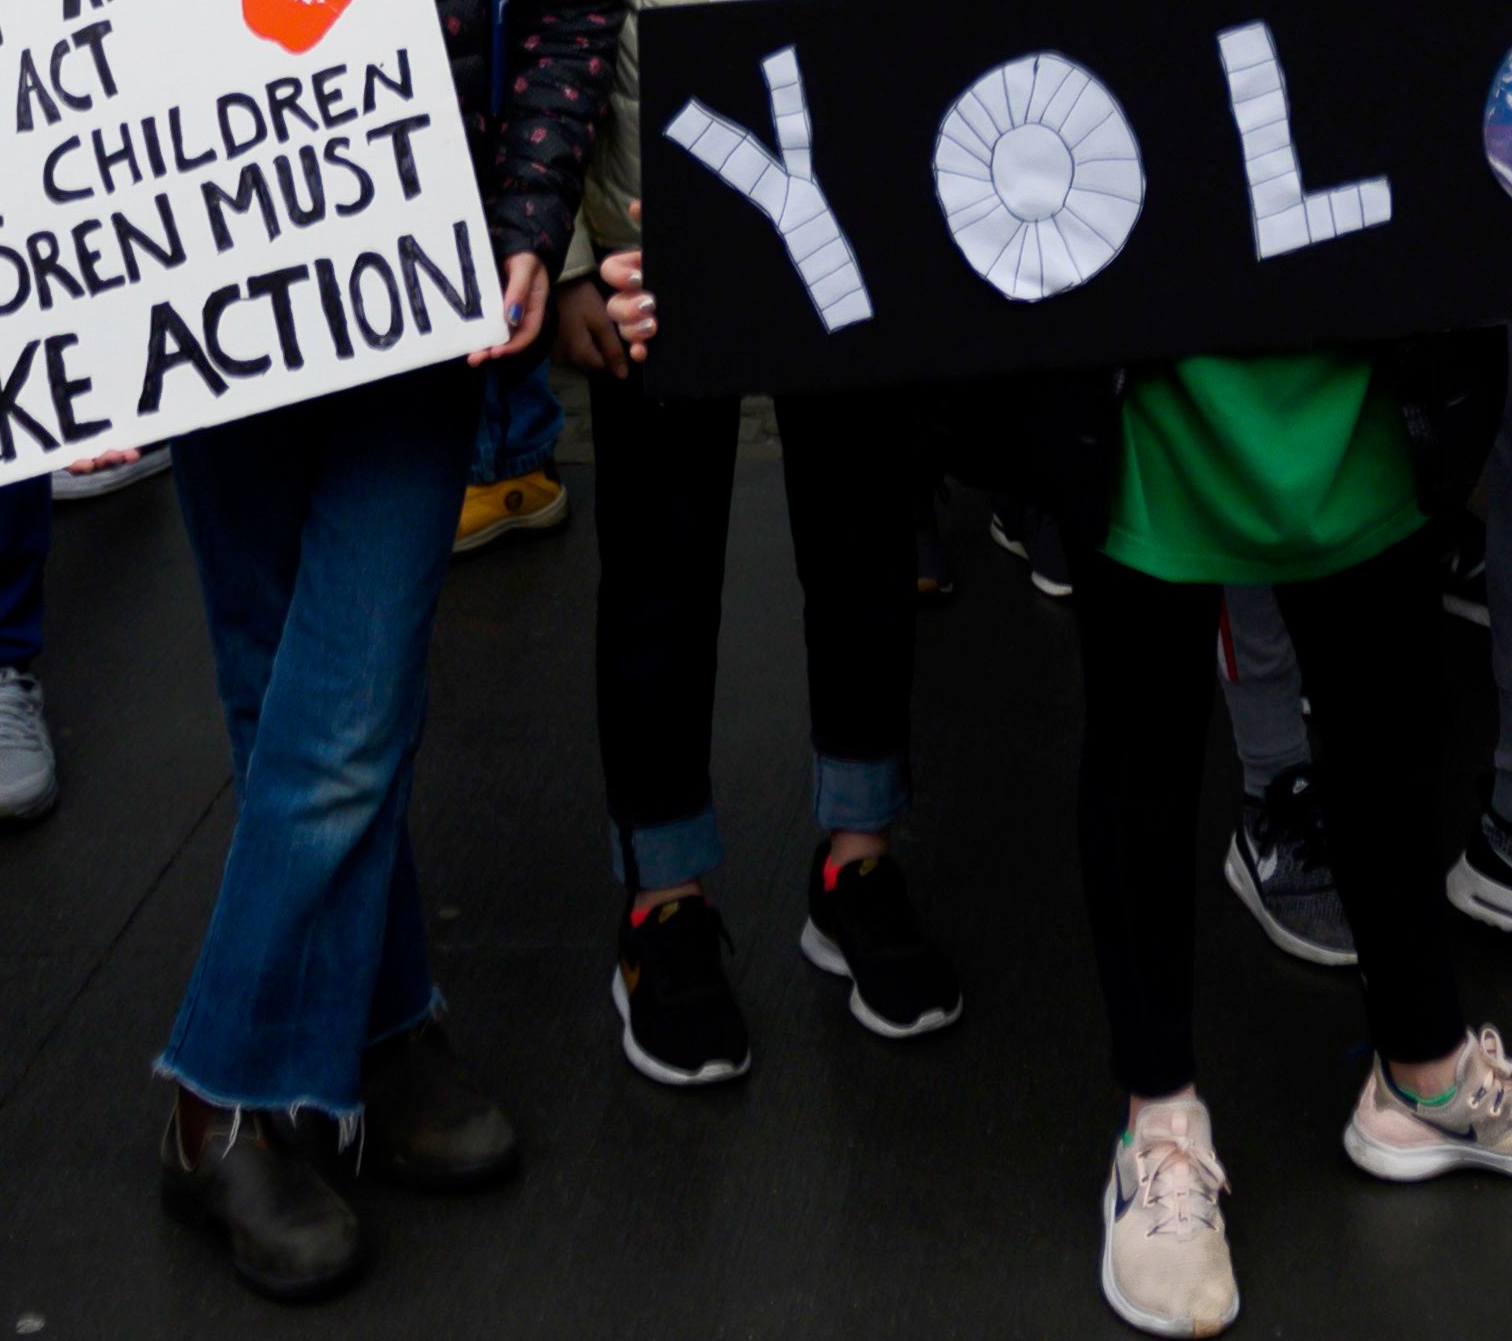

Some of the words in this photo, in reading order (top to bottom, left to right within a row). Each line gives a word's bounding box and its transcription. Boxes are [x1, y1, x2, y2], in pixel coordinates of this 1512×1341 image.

[15, 20, 120, 133] ACT
[43, 49, 415, 206] CHILDREN
[201, 115, 432, 254] MUST
[136, 219, 485, 418] ACTION
